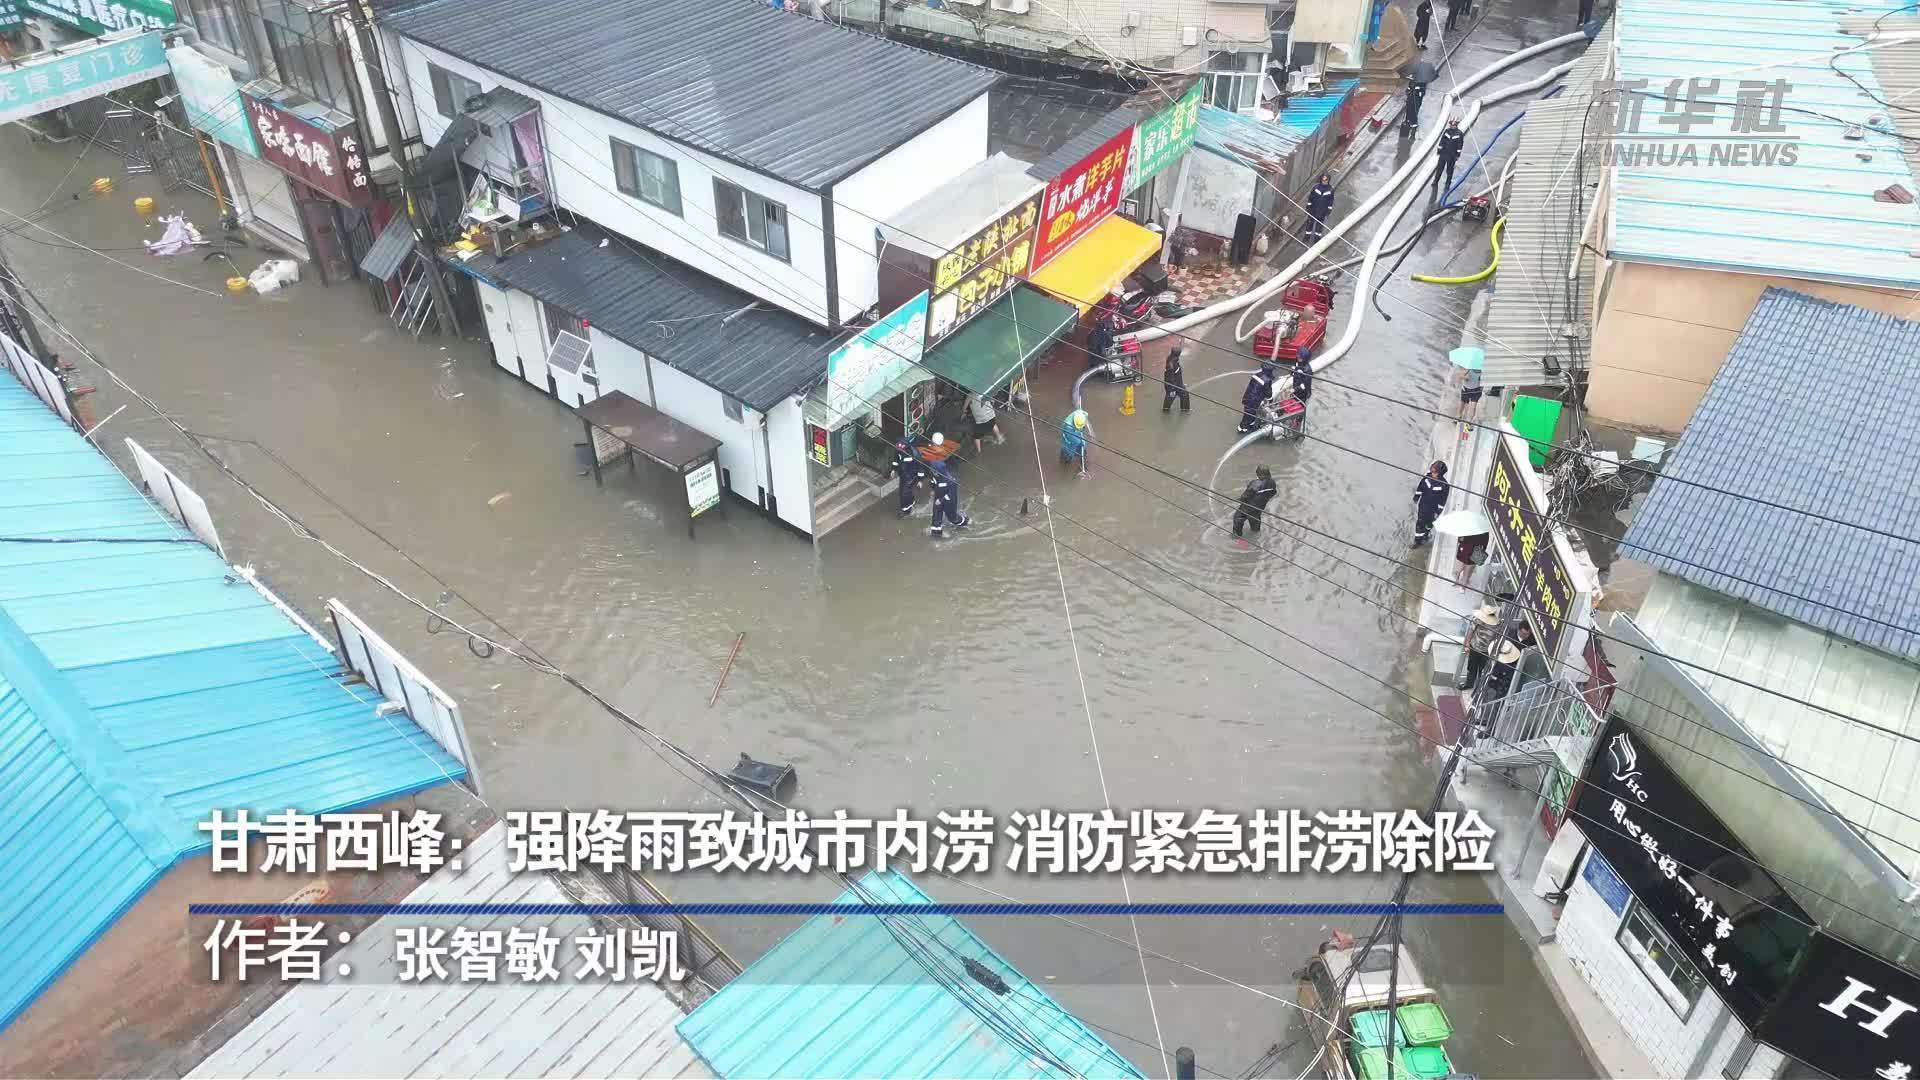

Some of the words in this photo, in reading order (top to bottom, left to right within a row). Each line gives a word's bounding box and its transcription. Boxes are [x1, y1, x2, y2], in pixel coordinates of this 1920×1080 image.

[1144, 93, 1200, 161] 家乐超市
[1625, 777, 1649, 803] HC
[1609, 798, 1734, 940] 用心做好一件事
[1817, 975, 1919, 1039] H
